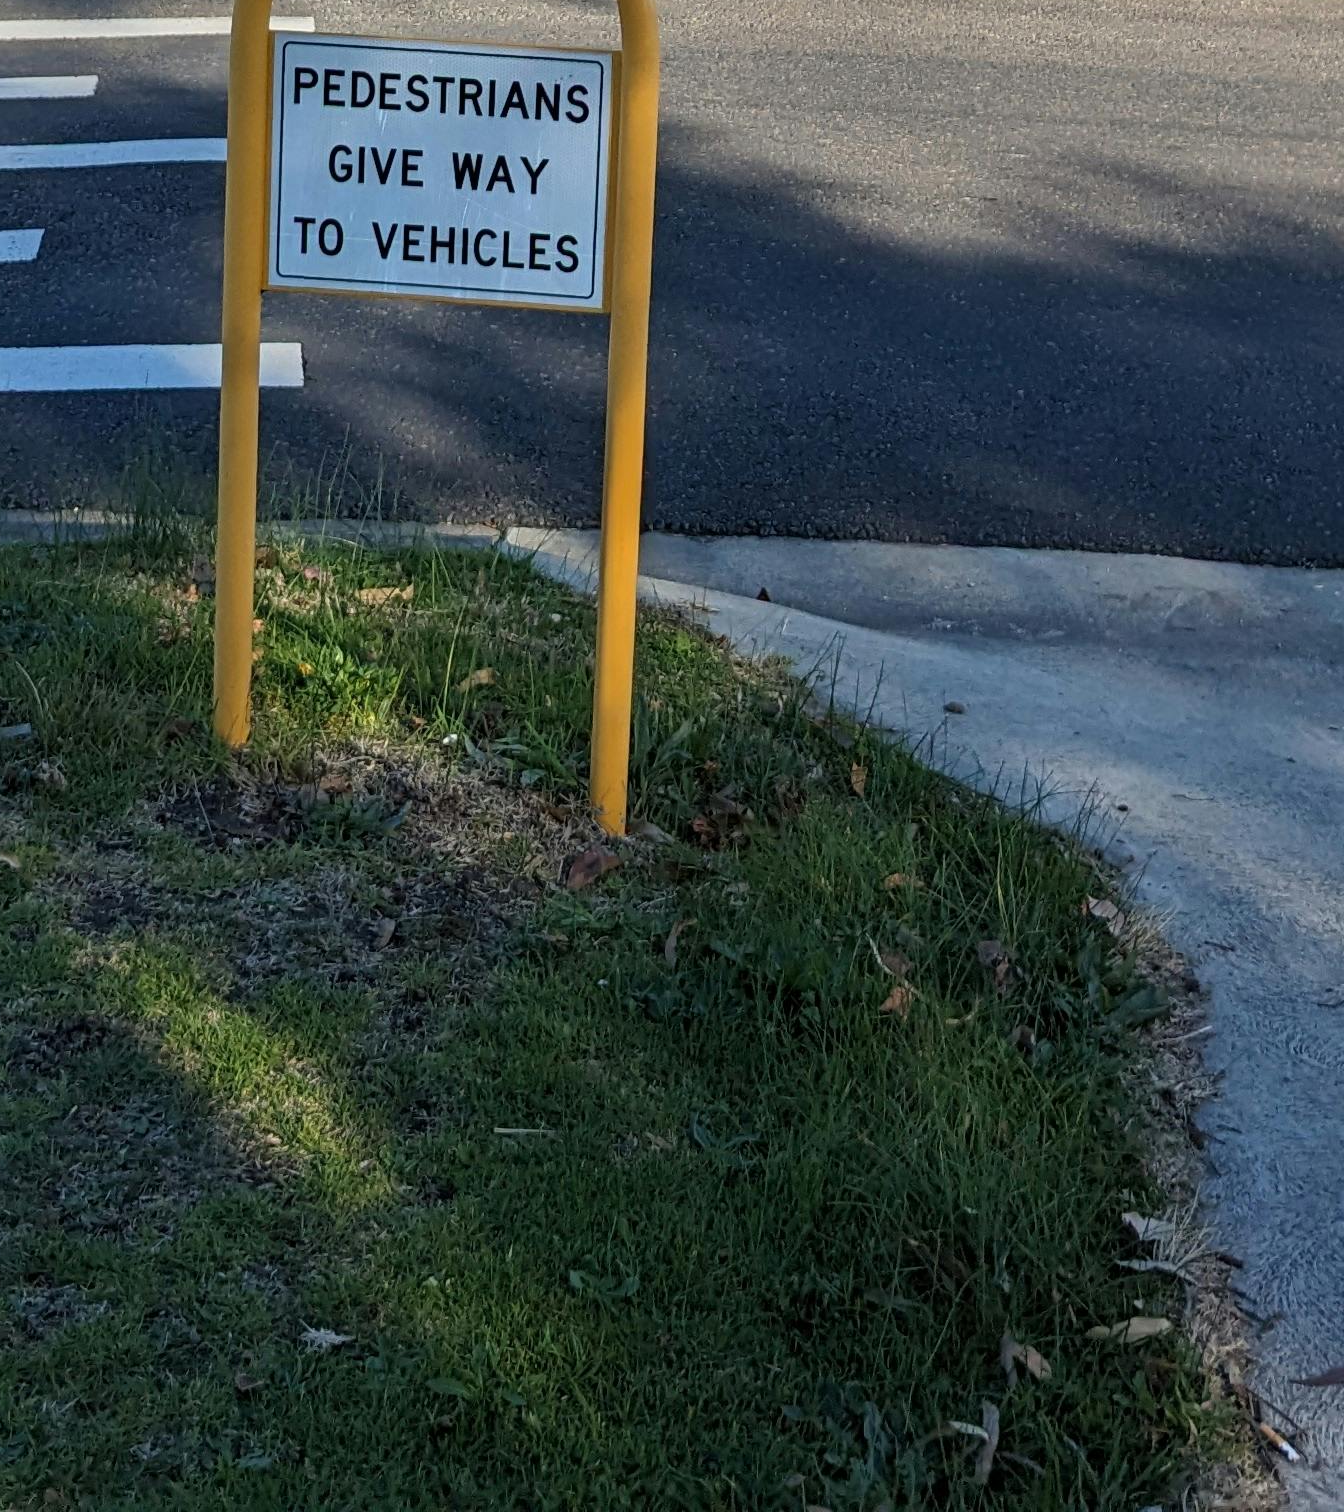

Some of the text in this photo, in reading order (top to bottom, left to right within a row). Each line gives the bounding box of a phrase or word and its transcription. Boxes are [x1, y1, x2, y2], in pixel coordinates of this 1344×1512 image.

[293, 66, 590, 124] PEDESTRIANS
[328, 144, 550, 195] GIVE WAY
[293, 216, 579, 273] TO VEHICLES
